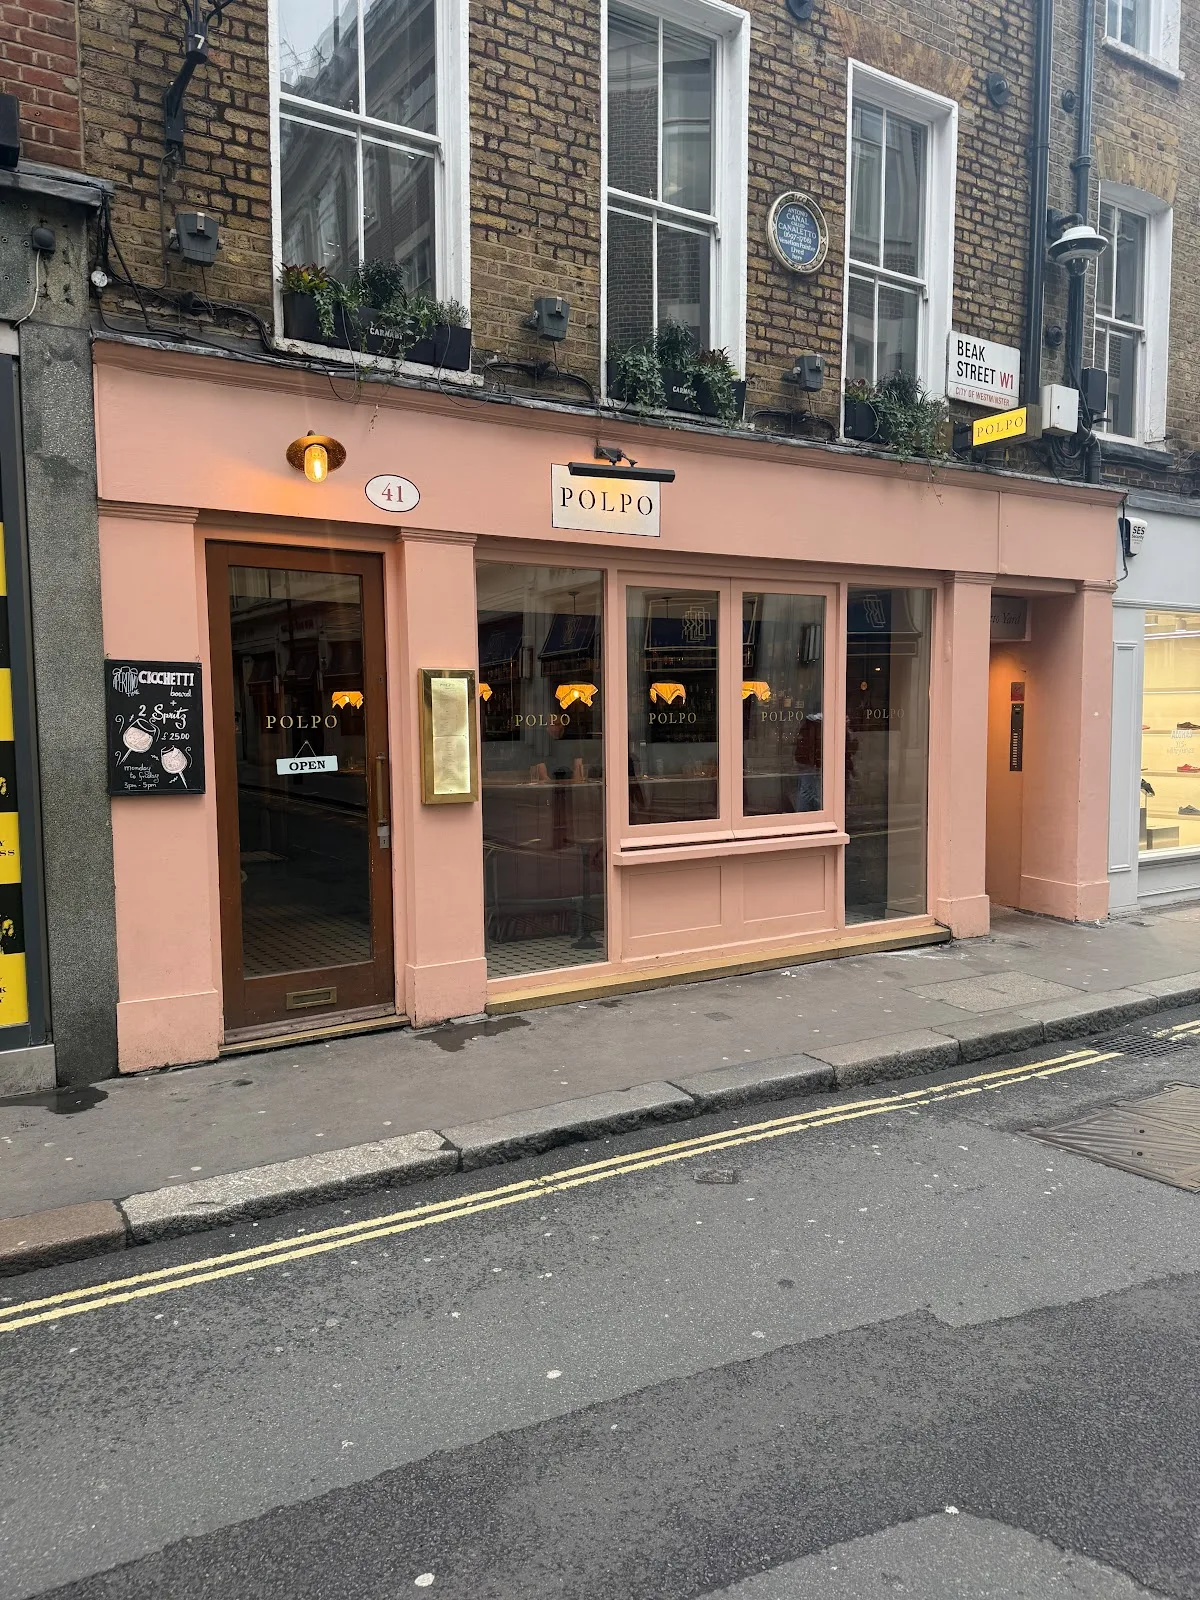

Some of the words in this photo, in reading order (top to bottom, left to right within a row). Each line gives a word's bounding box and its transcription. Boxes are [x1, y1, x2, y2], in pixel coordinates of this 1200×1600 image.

[788, 207, 808, 217] ANTONIO
[786, 213, 809, 226] CANAL
[778, 223, 817, 239] CANALETTO
[791, 247, 805, 256] Lived
[957, 339, 986, 362] BEAK
[956, 360, 996, 385] STREET
[1000, 371, 1014, 390] W1
[955, 386, 968, 397] CITY
[968, 389, 975, 398] OF
[975, 391, 1010, 407] WESTMINSTER
[976, 416, 1024, 438] POLPO
[381, 482, 404, 503] 41
[560, 486, 653, 516] POLPO
[1132, 525, 1146, 535] SES
[1001, 611, 1022, 625] Yard
[138, 670, 195, 687] CICCHETTI
[170, 686, 192, 697] board
[138, 704, 147, 717] 2
[152, 703, 189, 730] Spritz
[515, 713, 571, 727] POLPO
[649, 712, 697, 724] POLPO
[761, 710, 804, 722] POLPO
[866, 708, 905, 719] POLPO
[265, 715, 338, 729] POLPO
[289, 760, 326, 771] OPEN
[129, 772, 137, 780] to
[124, 782, 137, 790] 3pm
[142, 782, 157, 790] 5pm
